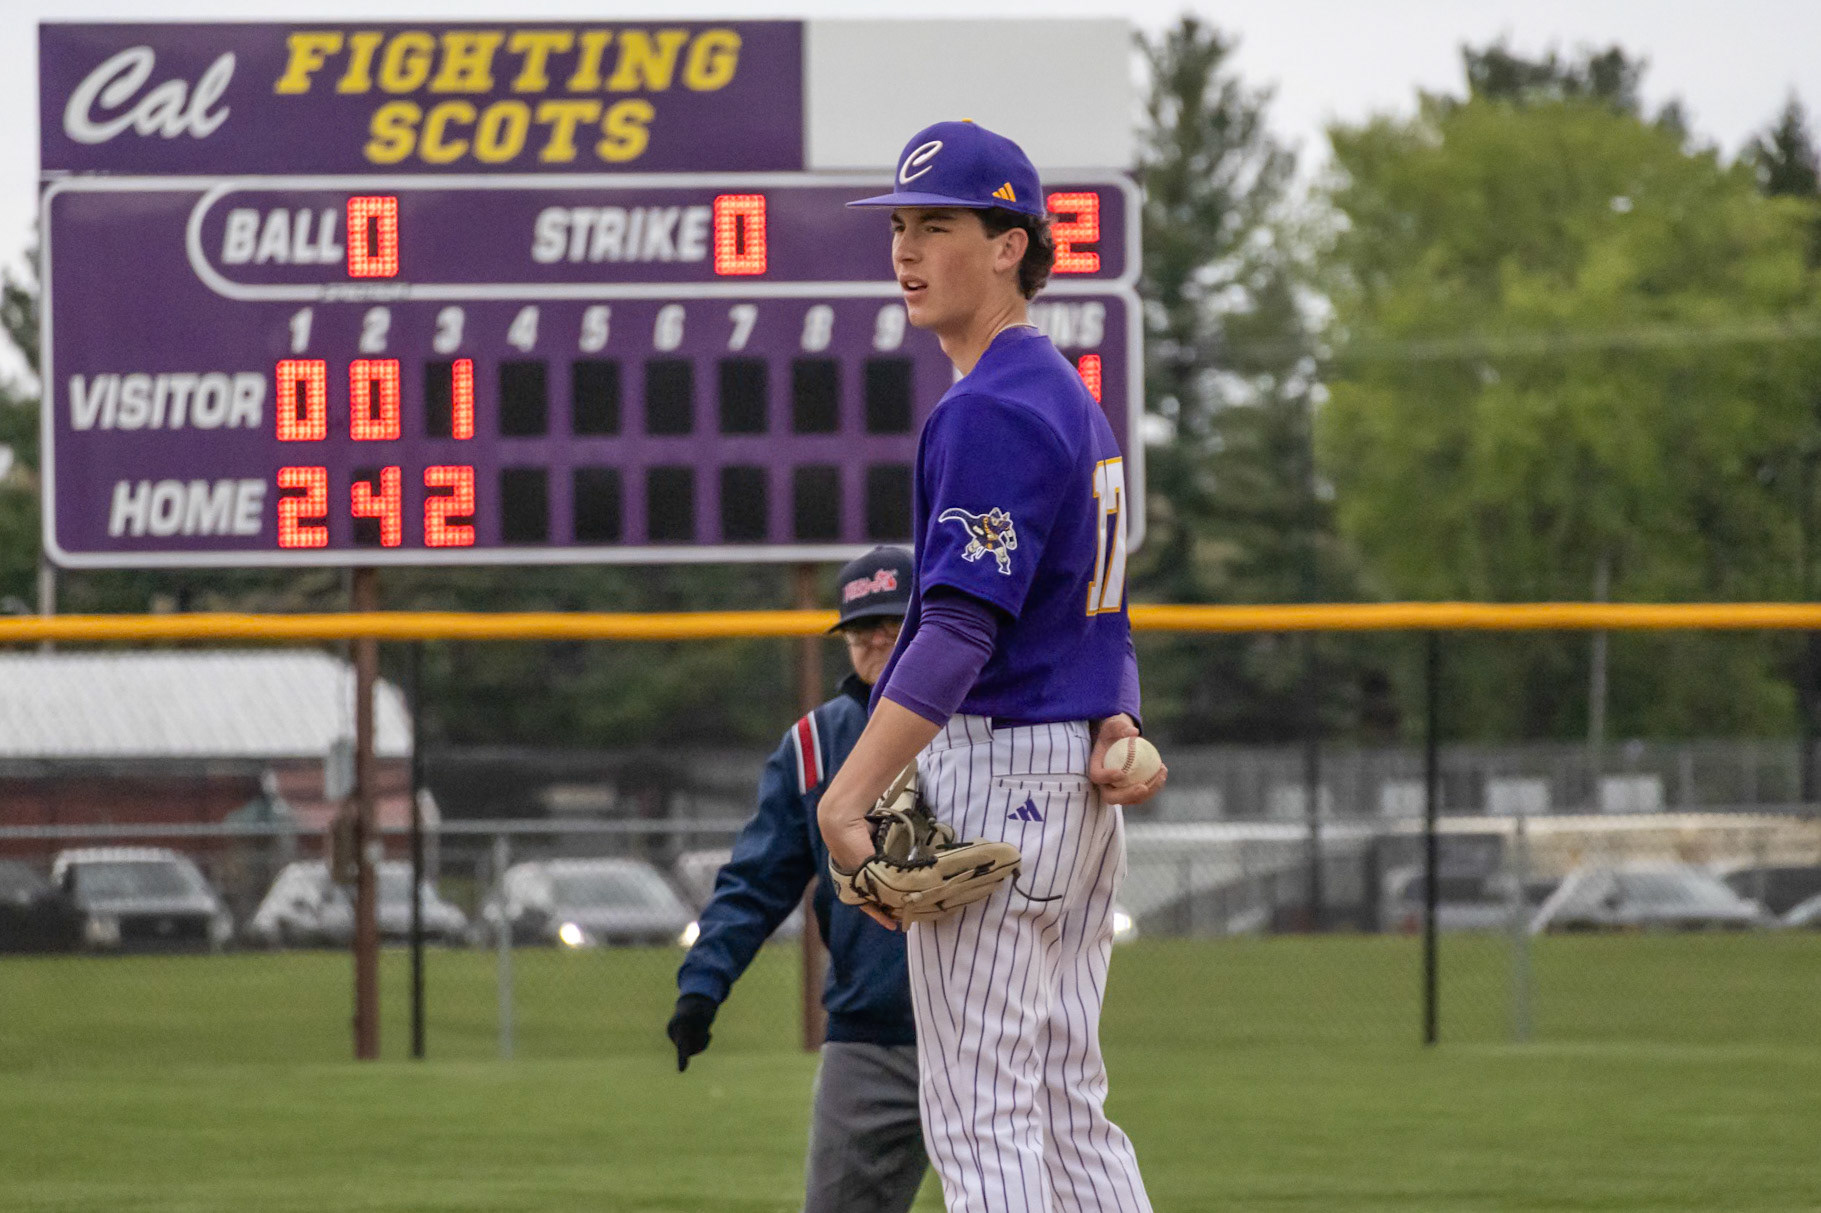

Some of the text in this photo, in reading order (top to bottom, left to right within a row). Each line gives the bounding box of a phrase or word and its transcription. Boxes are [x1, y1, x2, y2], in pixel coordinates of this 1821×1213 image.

[63, 45, 236, 144] Cal
[275, 30, 741, 94] FIGHTING
[365, 100, 655, 164] SCOTS
[221, 207, 345, 265] BALL
[347, 196, 399, 278] 0
[531, 206, 711, 263] STRIKE
[714, 194, 767, 276] 0
[1047, 191, 1100, 273] 2
[290, 304, 906, 353] 1 2 3 4 5 6 7 8 9
[69, 372, 267, 430] VISITOR
[276, 358, 474, 441] 0 0 1
[108, 479, 267, 537] HOME
[277, 465, 475, 548] 2 4 2
[1086, 456, 1127, 616] 17
